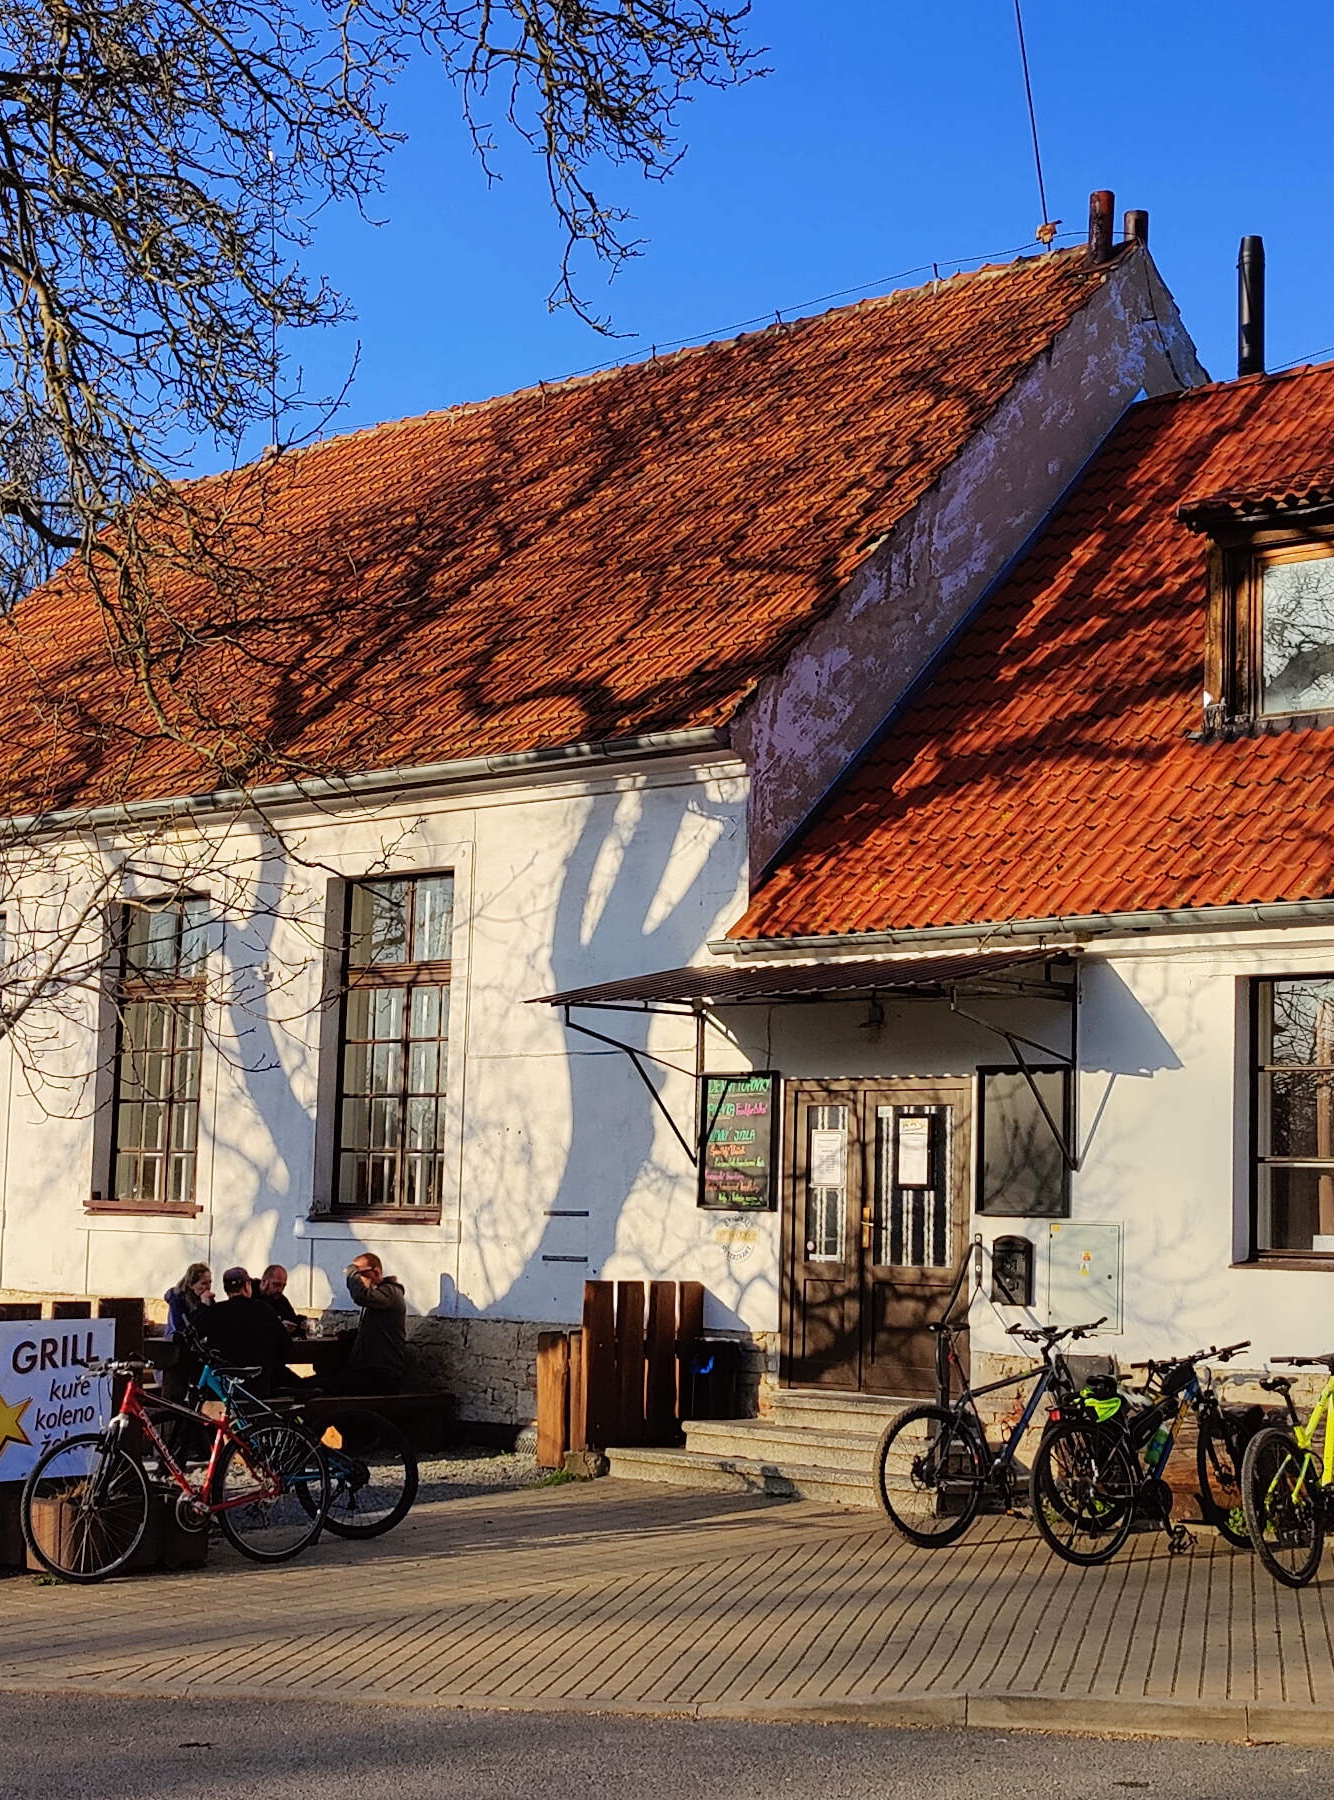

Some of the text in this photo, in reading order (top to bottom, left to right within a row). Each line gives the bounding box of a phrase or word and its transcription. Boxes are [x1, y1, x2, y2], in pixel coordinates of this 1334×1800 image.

[12, 1332, 100, 1374] GRILL
[49, 1376, 91, 1402] kuře
[35, 1404, 94, 1431] koleno
